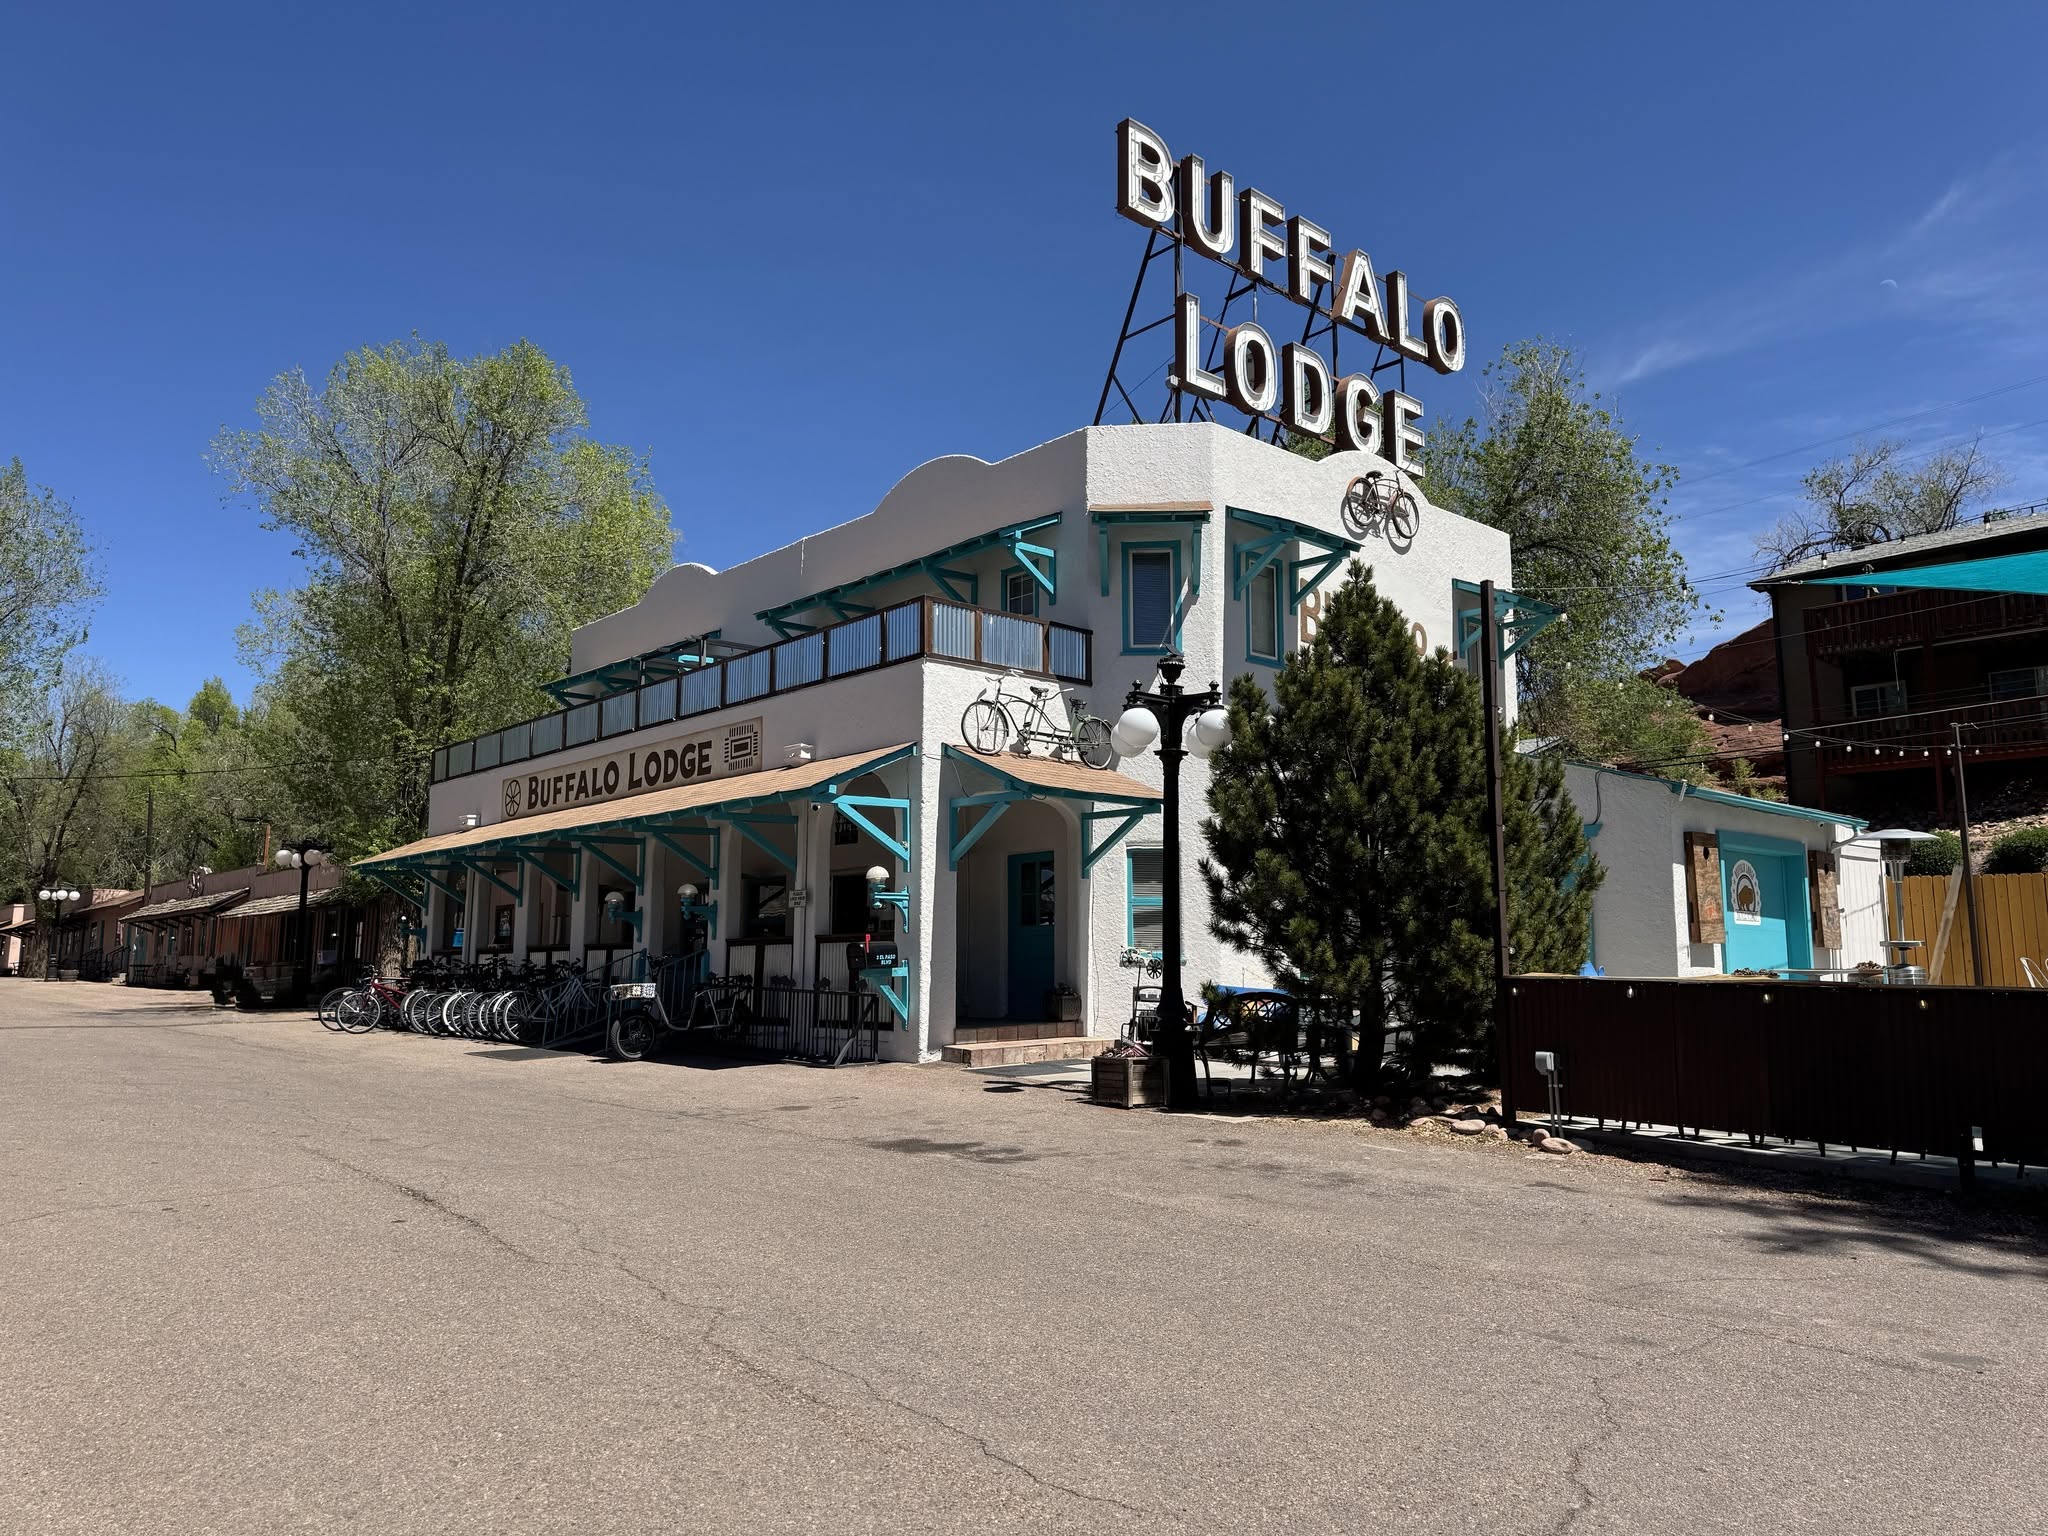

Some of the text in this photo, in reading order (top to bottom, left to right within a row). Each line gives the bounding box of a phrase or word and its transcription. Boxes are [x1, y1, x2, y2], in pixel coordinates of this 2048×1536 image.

[1117, 117, 1466, 375] BUFFALO
[1174, 291, 1426, 479] LODGE
[527, 740, 713, 811] BUFFALO LODGE
